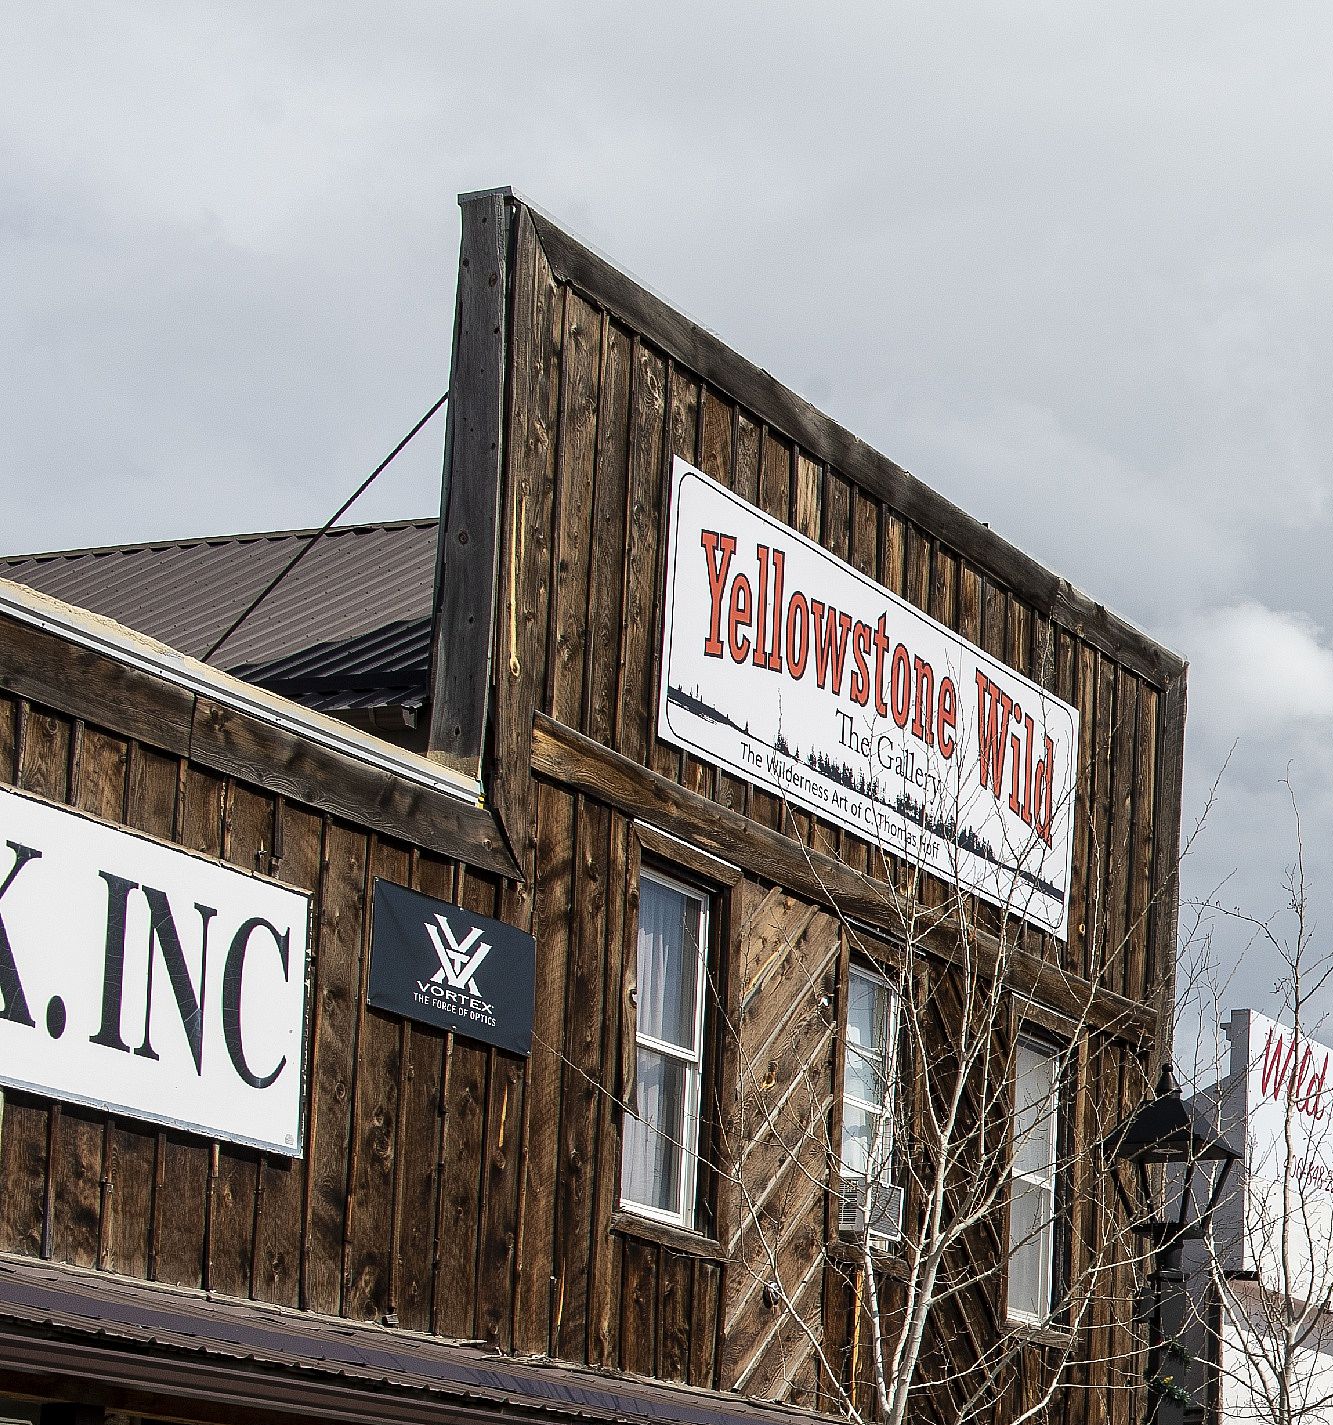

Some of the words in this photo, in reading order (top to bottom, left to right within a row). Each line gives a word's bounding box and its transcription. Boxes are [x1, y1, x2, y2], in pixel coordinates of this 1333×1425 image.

[701, 529, 957, 760] Yellowstone
[975, 667, 1054, 850] Wild
[741, 741, 763, 768] The
[766, 754, 829, 802] Wilderness
[832, 789, 848, 813] Art
[851, 802, 863, 818] of
[878, 812, 917, 849] Thomas
[835, 707, 871, 758] The
[877, 735, 941, 804] Gallery
[413, 992, 430, 1005] THE
[432, 998, 457, 1014] FORCE
[458, 1007, 469, 1017] OF
[469, 1010, 497, 1027] OPTICS
[416, 980, 493, 1015] VORTEX
[1261, 1026, 1329, 1120] Wild
